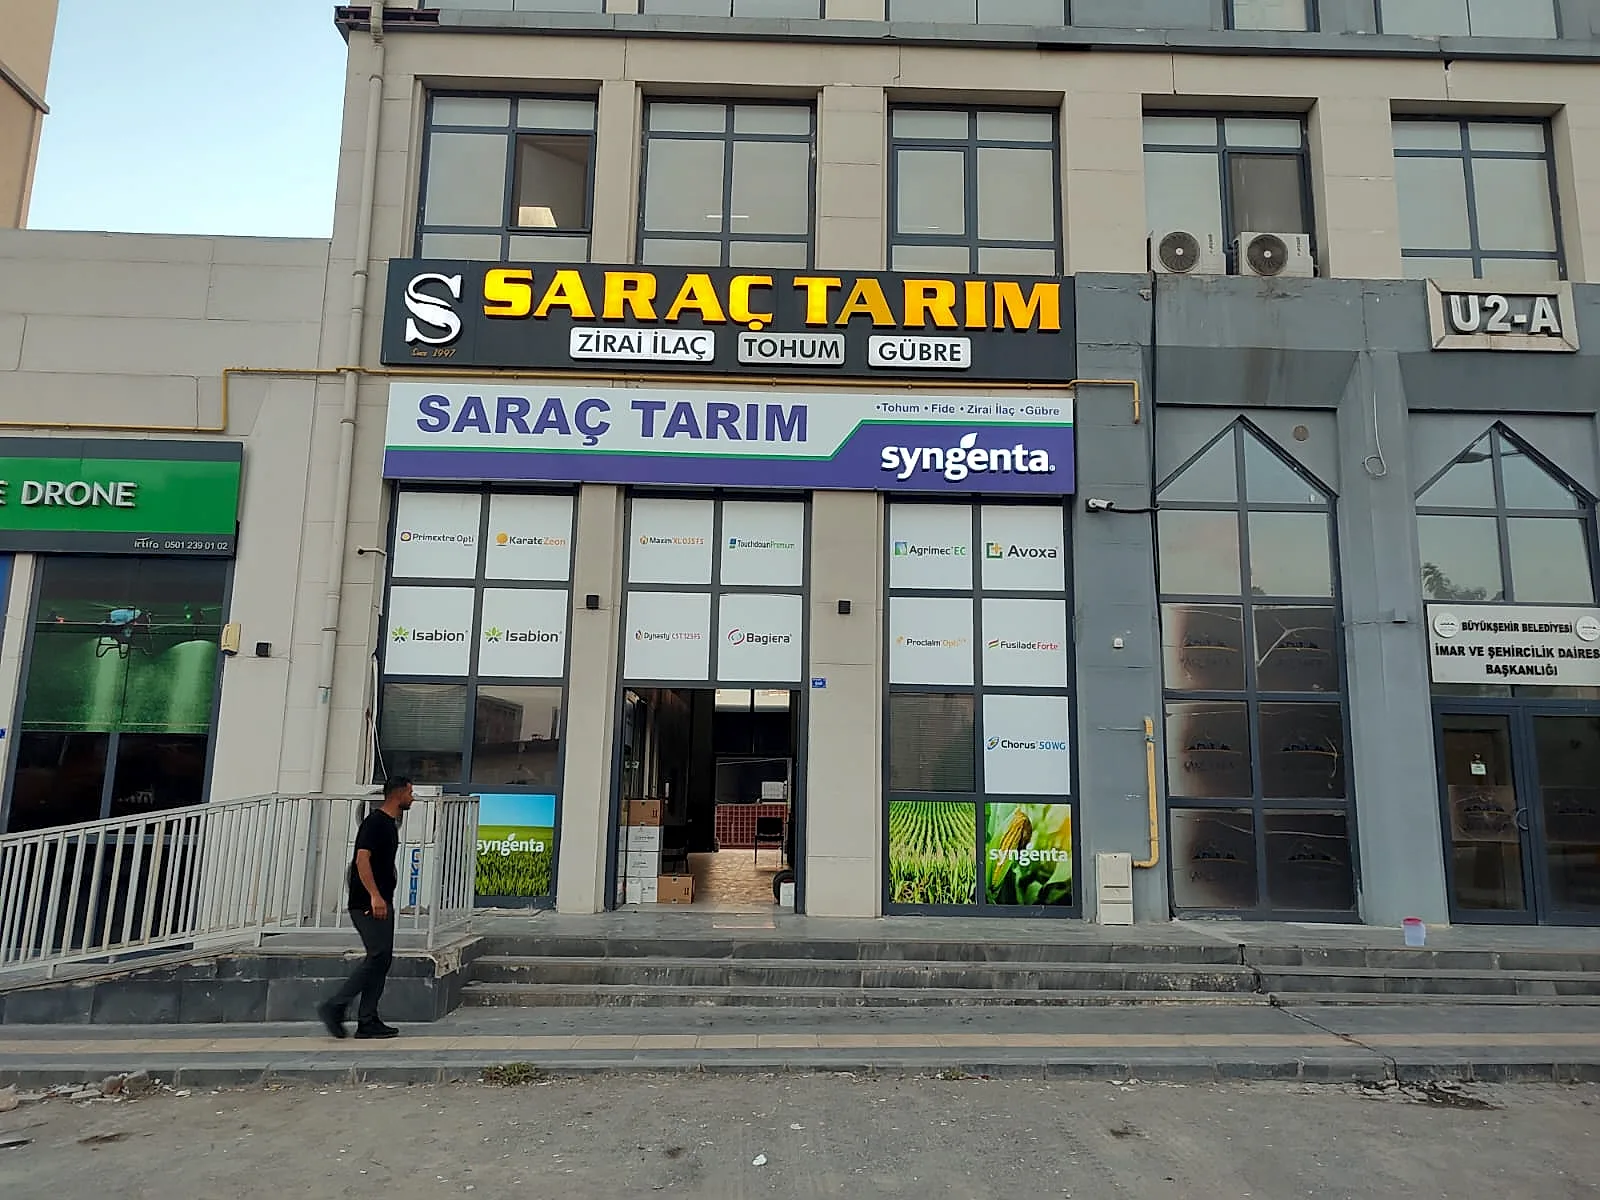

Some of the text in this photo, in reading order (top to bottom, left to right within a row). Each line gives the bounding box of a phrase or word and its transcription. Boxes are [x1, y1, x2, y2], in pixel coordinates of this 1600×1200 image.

[483, 268, 1062, 332] SARAÇ TARIM
[1450, 294, 1562, 336] U2-A
[578, 330, 707, 360] ZİRAİ İLAÇ
[743, 338, 840, 359] TOHUM
[878, 339, 961, 362] GÜBRE
[432, 348, 456, 359] 1997
[881, 402, 920, 414] Tohum
[931, 403, 955, 414] Fide
[1025, 405, 1060, 417] Gübre
[416, 394, 808, 446] SARAÇ TARIM
[880, 441, 1051, 482] syngenta
[21, 480, 137, 507] DRONE
[164, 541, 185, 550] 0501
[187, 541, 203, 550] 239
[204, 542, 215, 550] 01
[217, 542, 228, 550] 02
[1007, 545, 1057, 558] Avoxa
[1462, 620, 1573, 634] BÜYÜKŞEHİR BELEDİYESİ
[412, 629, 465, 642] Isabion
[506, 630, 559, 643] Isabion
[746, 633, 790, 645] Bagiera
[1435, 643, 1466, 657] İMAR
[1469, 646, 1485, 657] VE
[1488, 645, 1556, 659] ŞEHİRCİLİK
[1486, 664, 1558, 678] BAŞKANLIĞI
[1001, 740, 1036, 750] Chorus
[988, 845, 1068, 866] syngenta
